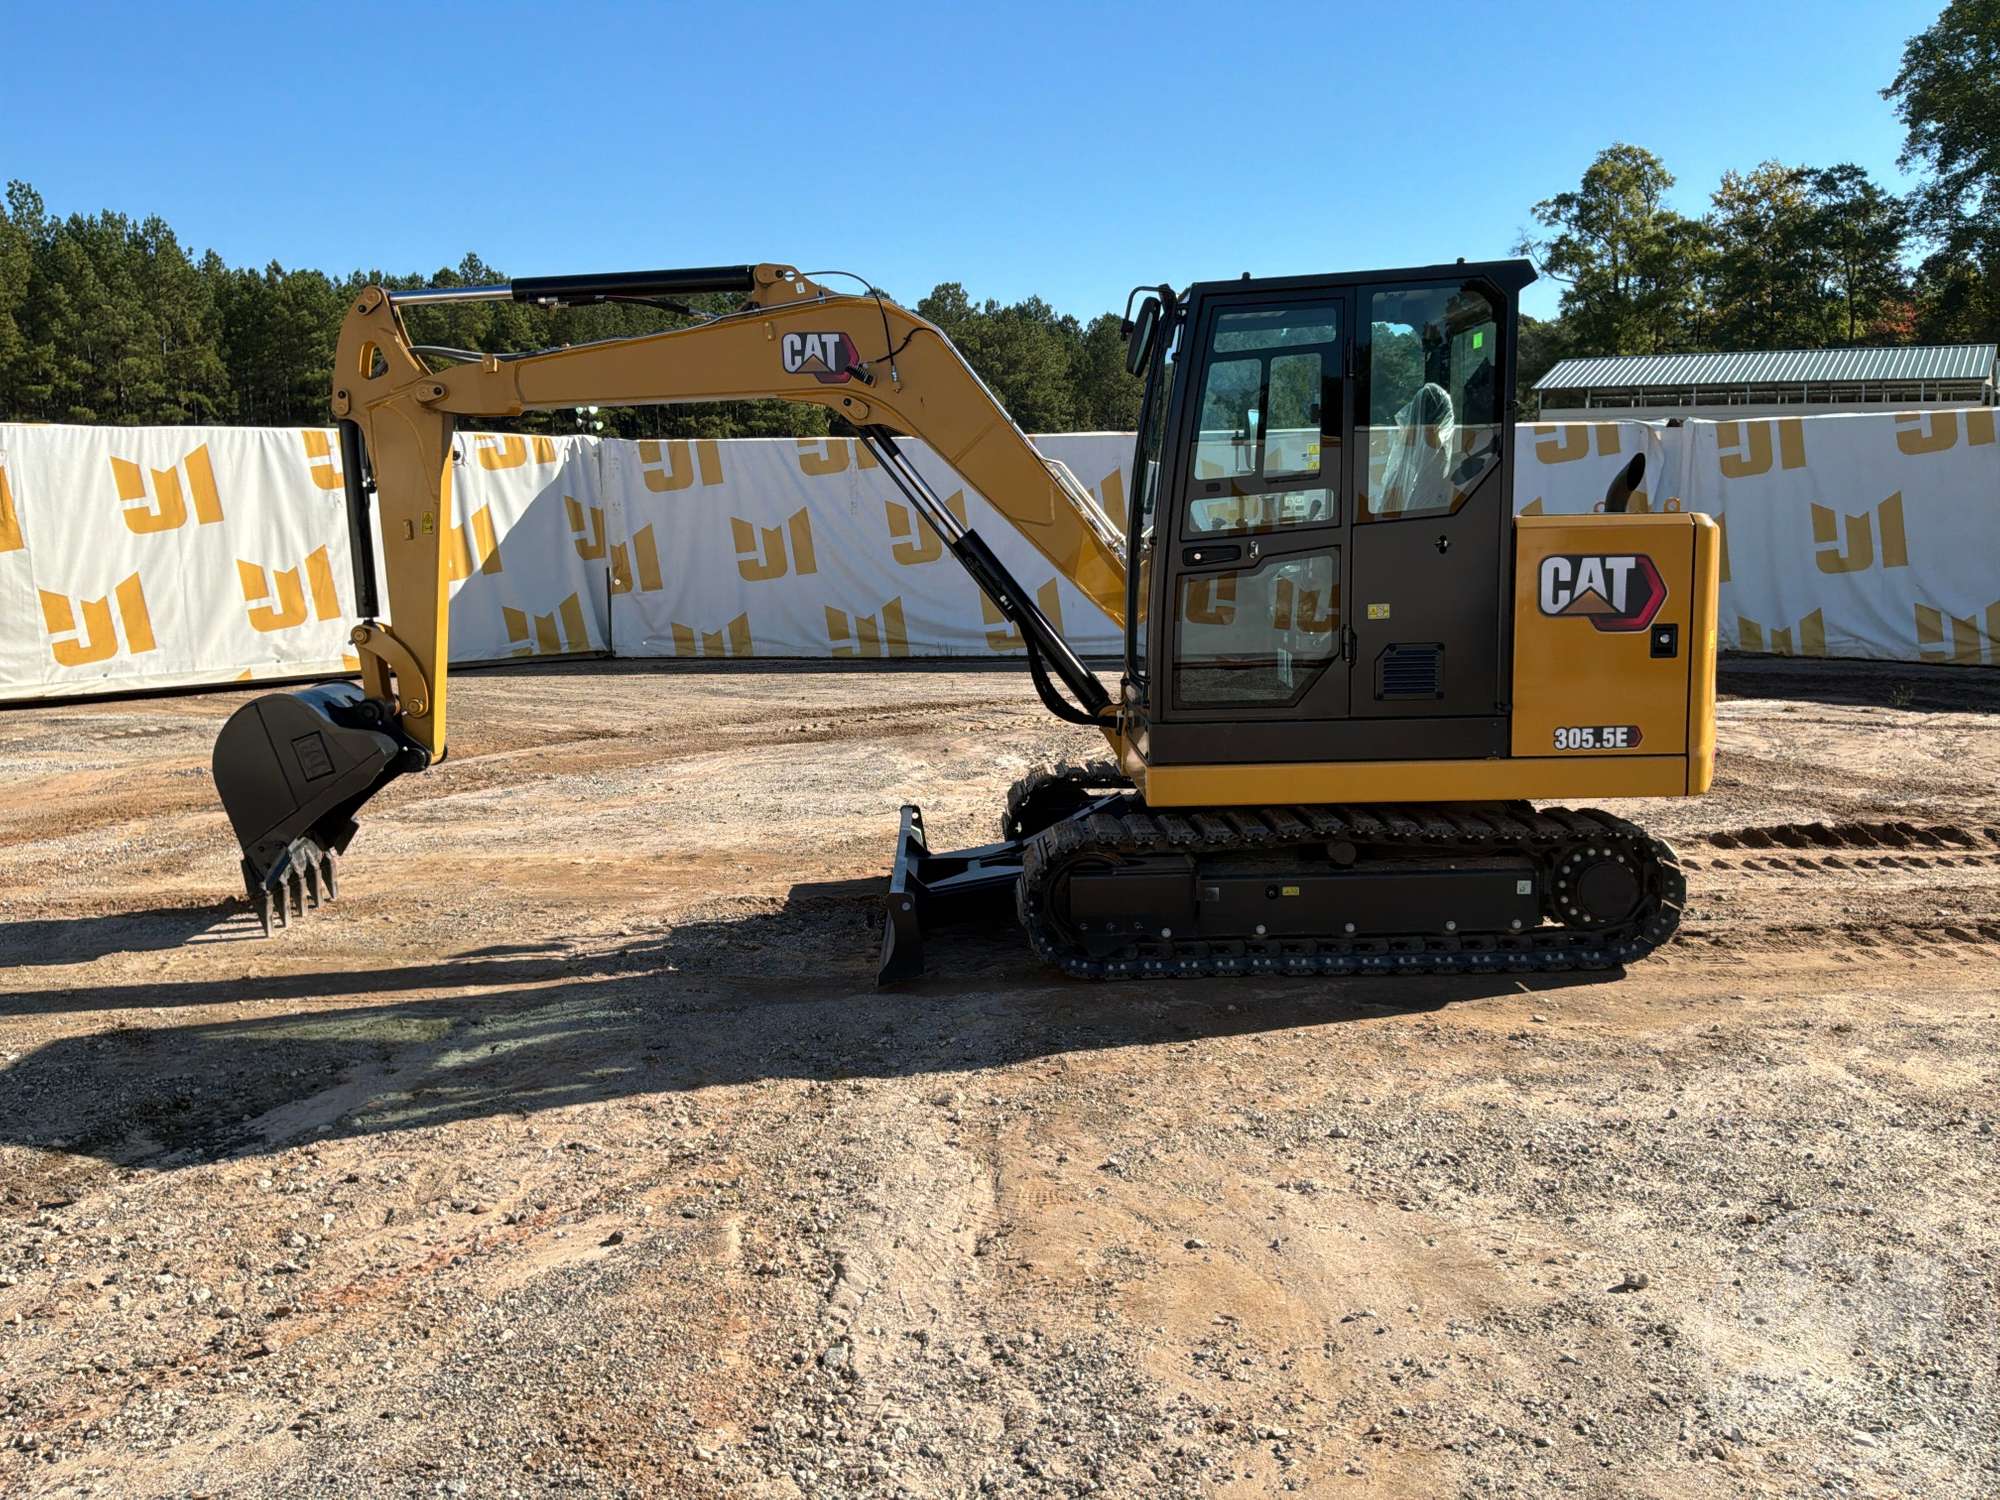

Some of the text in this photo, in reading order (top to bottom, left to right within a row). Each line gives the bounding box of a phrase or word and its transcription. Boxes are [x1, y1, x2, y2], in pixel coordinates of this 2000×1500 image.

[782, 333, 840, 373] CAT
[1540, 556, 1636, 615] CAT
[1554, 727, 1628, 749] 305.5E
